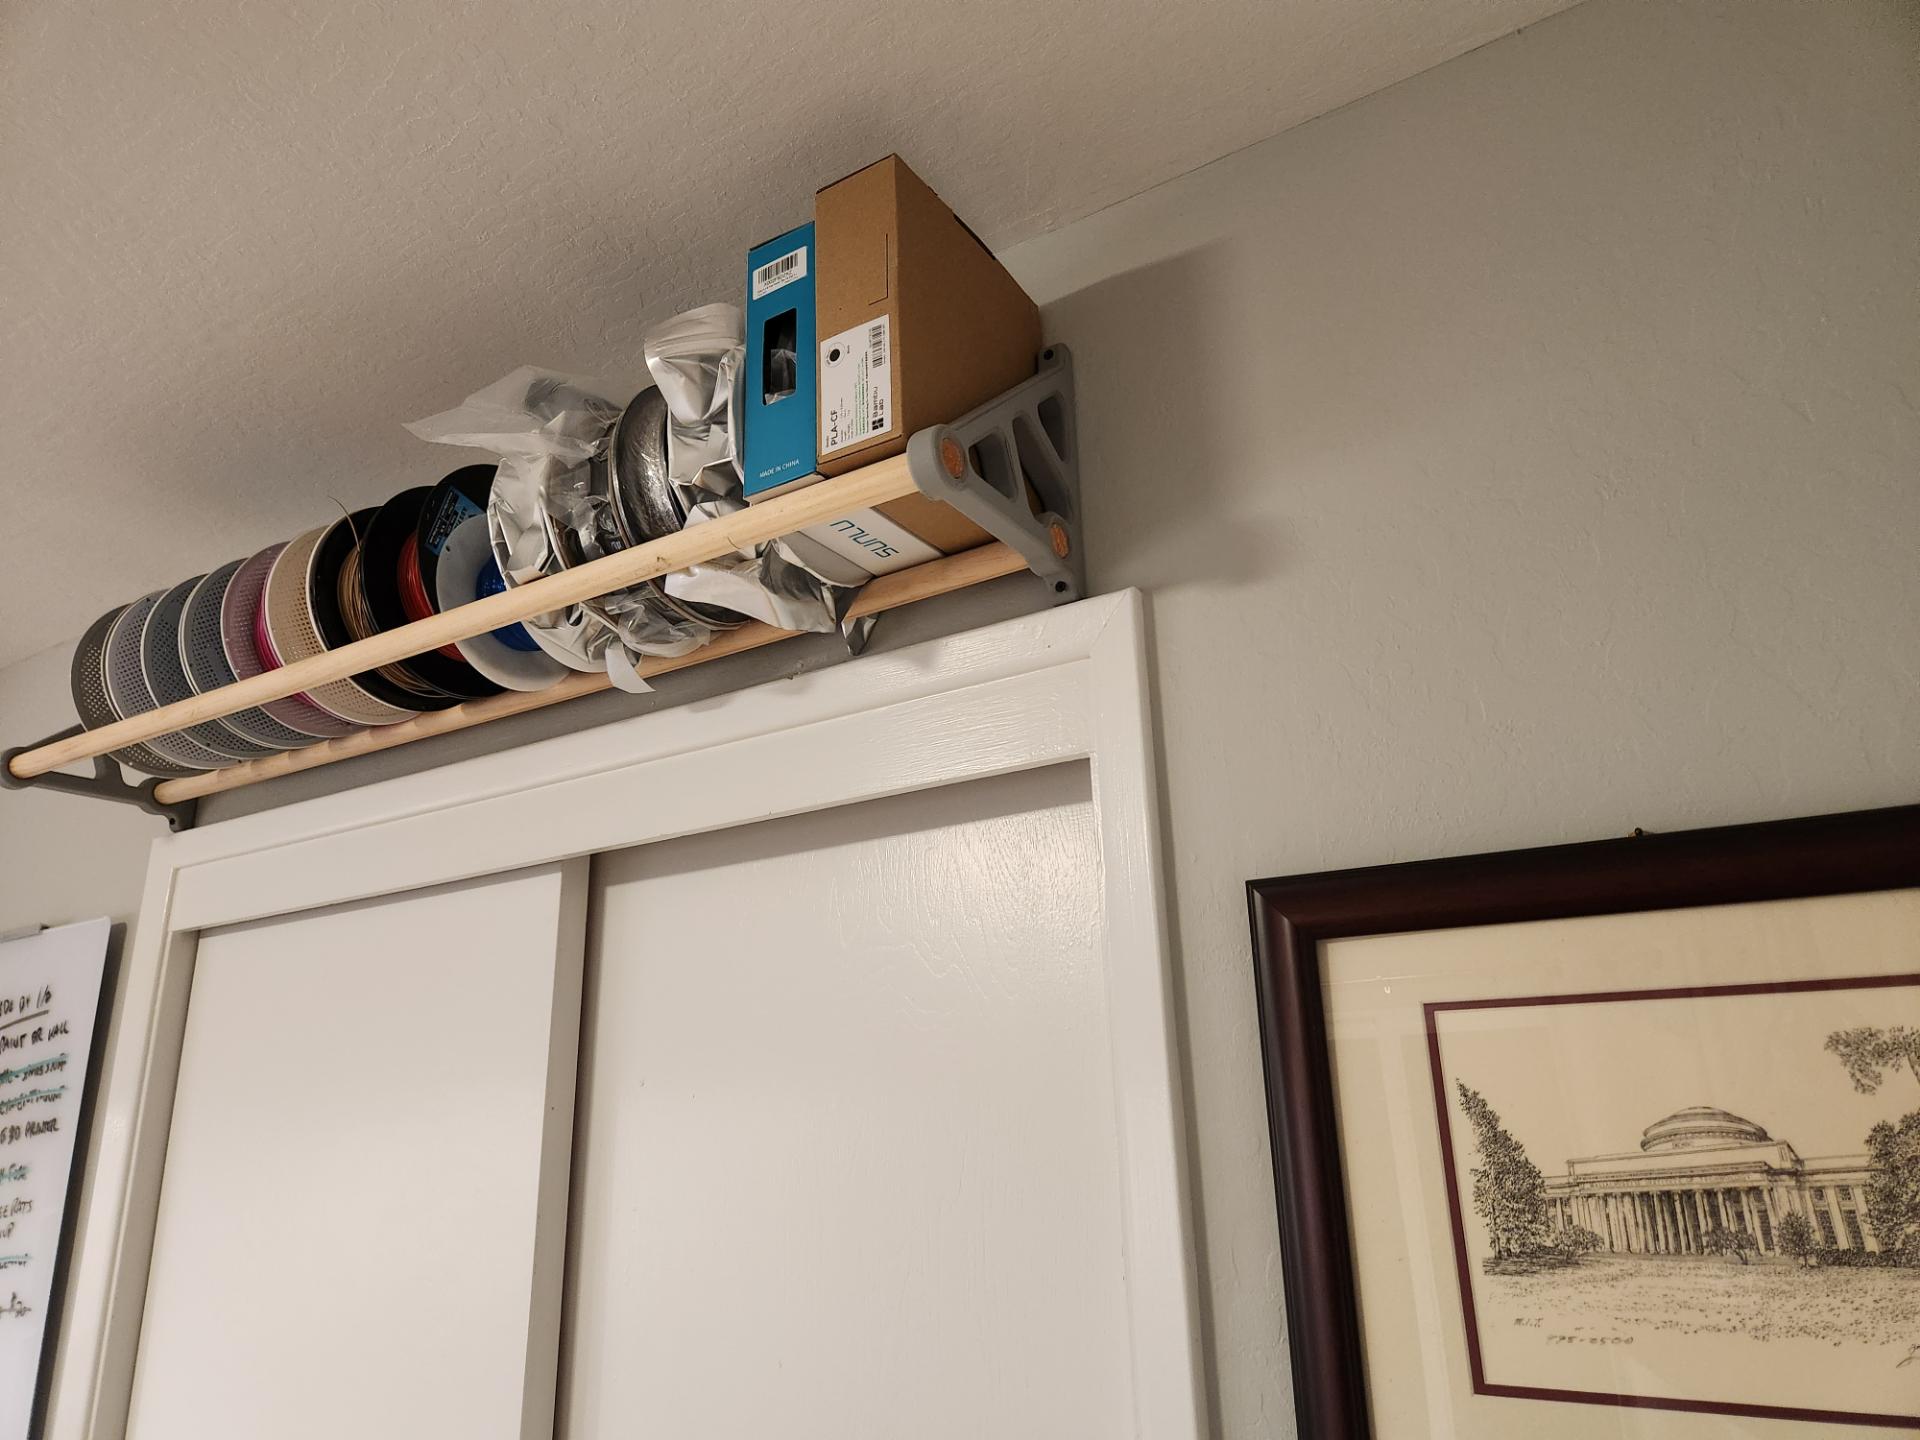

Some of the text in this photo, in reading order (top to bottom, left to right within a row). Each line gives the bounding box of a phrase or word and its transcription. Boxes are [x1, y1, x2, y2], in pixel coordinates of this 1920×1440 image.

[830, 410, 838, 446] PLA-CF
[759, 458, 800, 478] MADE IN CHINA
[829, 519, 900, 558] SUNLU
